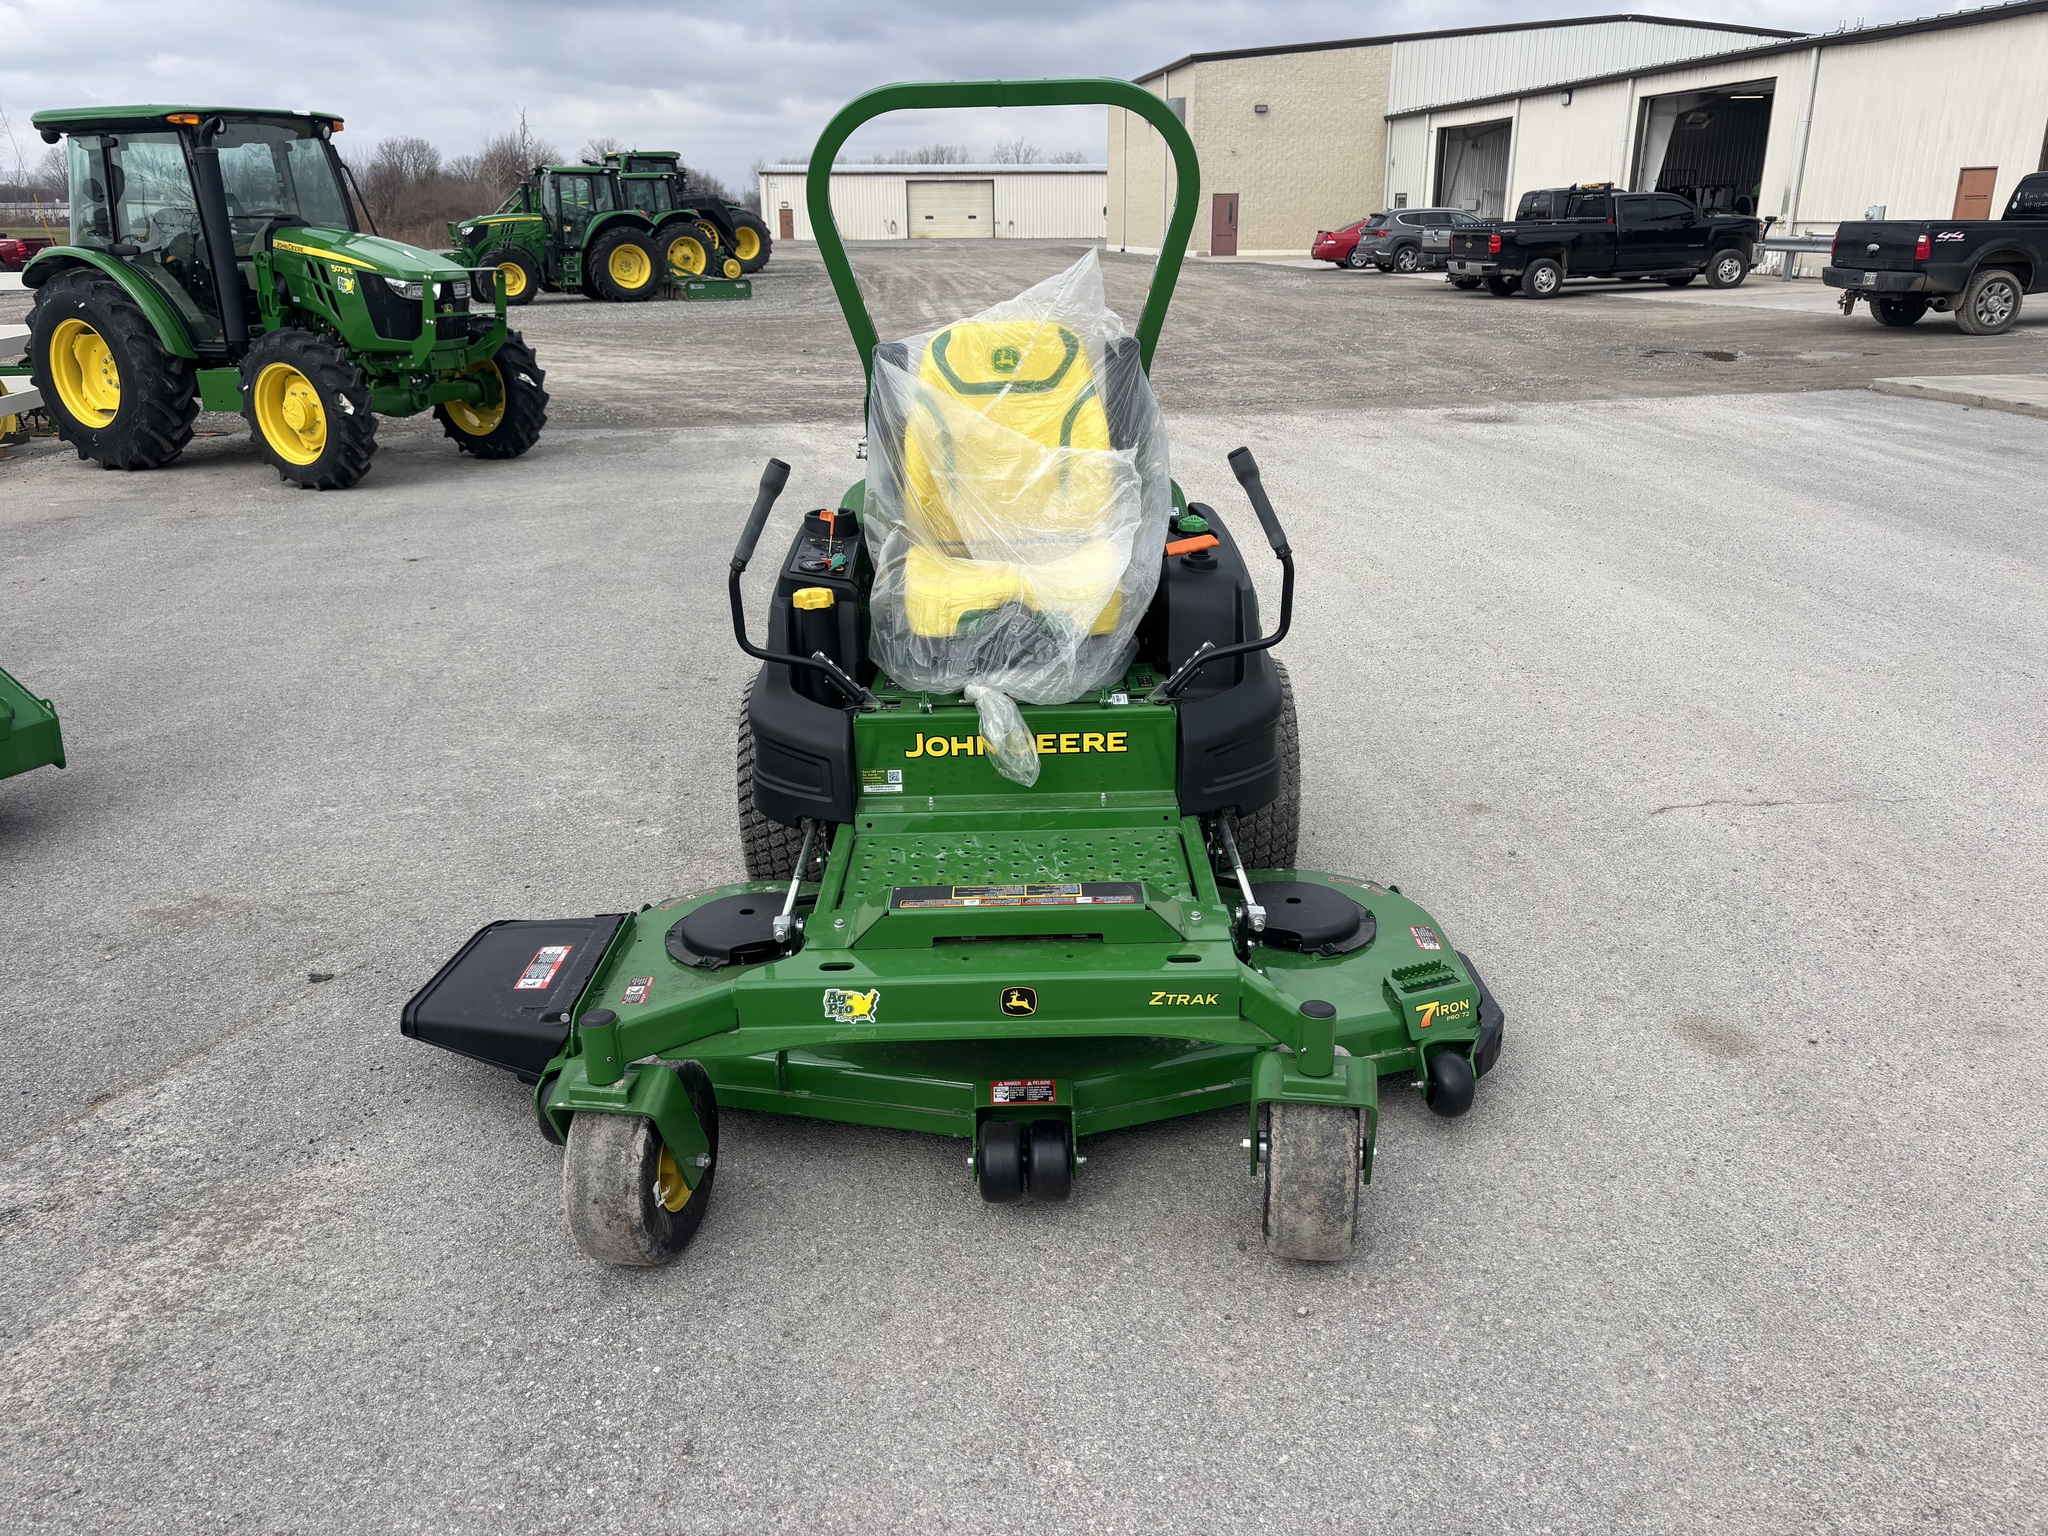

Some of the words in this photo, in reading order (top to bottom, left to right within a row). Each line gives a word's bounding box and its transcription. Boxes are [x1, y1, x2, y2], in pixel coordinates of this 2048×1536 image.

[276, 241, 288, 250] JOHN
[288, 243, 304, 253] DEERE
[1148, 991, 1220, 1006] ZTRAK
[827, 1003, 854, 1016] Pro
[1446, 1014, 1460, 1022] PRO
